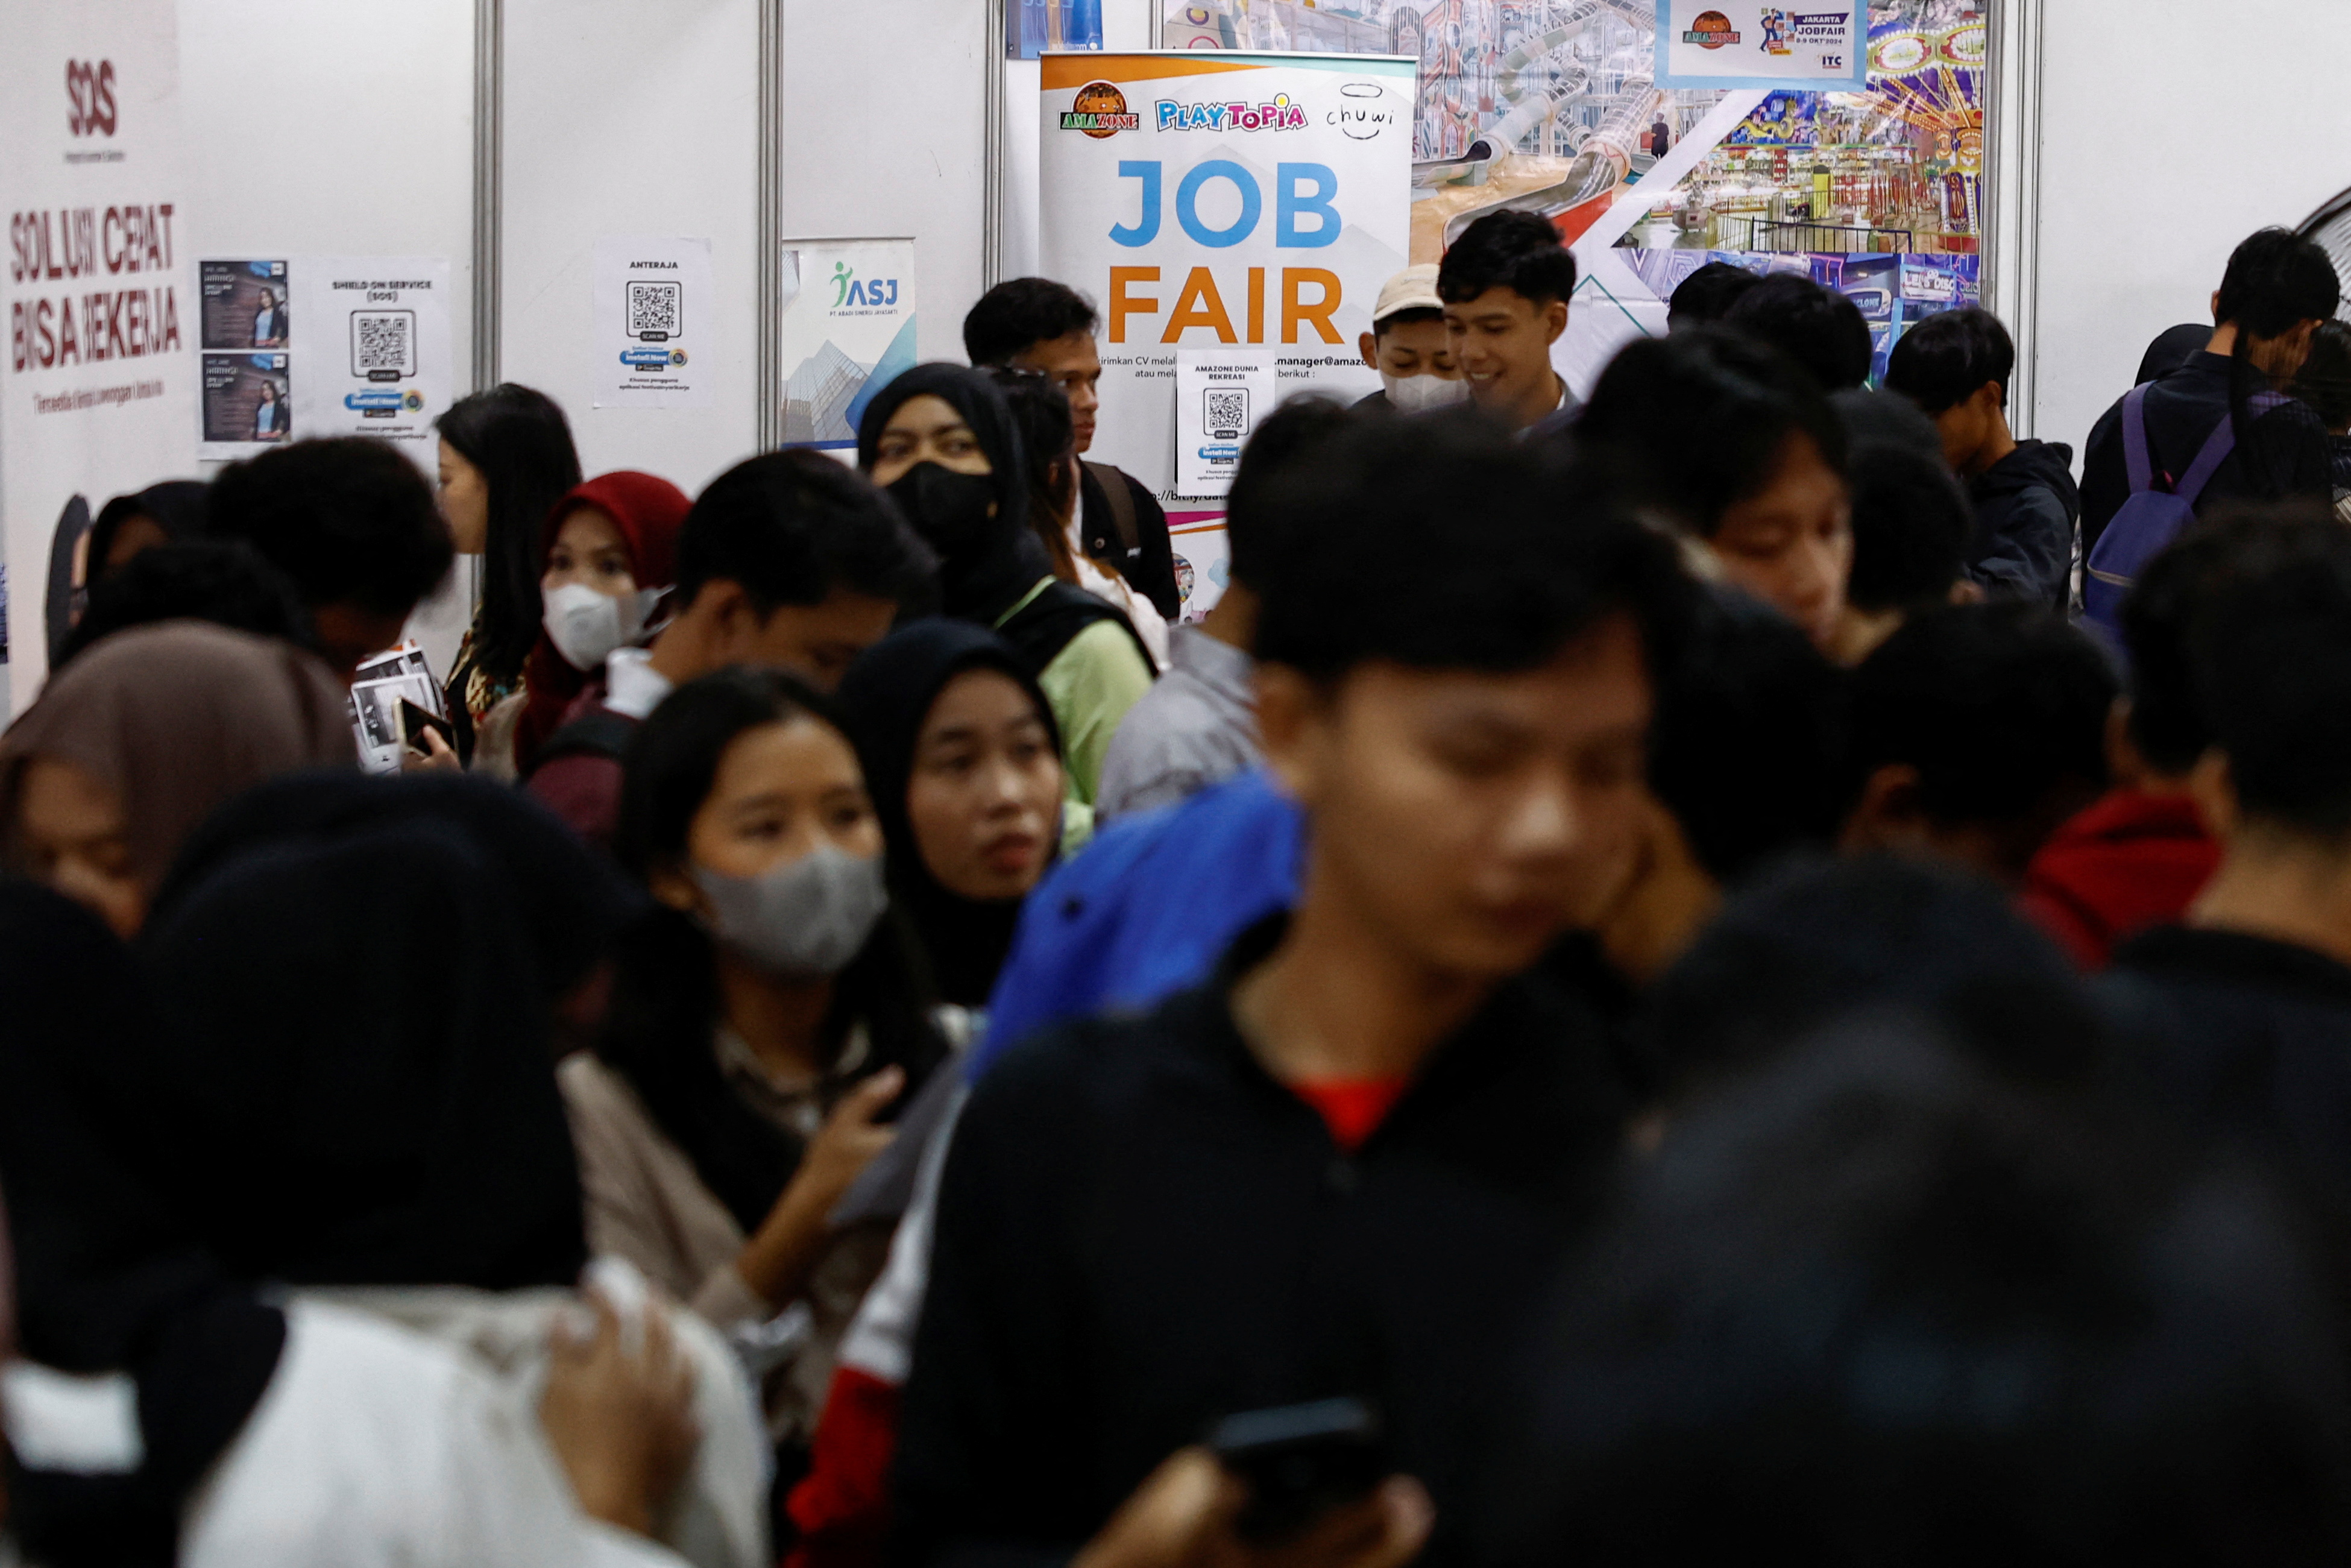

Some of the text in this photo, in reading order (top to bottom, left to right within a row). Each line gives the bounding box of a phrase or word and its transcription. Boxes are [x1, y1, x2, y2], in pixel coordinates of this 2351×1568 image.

[1684, 32, 1739, 43] AMAZONE
[1798, 27, 1845, 36] JOBFAIR
[1822, 56, 1842, 65] ITC
[66, 59, 116, 137] SOS
[1062, 113, 1138, 129] AMAZONE
[1327, 104, 1394, 125] chuwi
[1108, 159, 1342, 248] JOB
[104, 204, 174, 274] CEPAT
[846, 279, 898, 306] ASJ
[1109, 265, 1345, 345] FAIR
[1098, 356, 1133, 365] irimkan
[1135, 356, 1149, 365] CV
[1278, 369, 1309, 378] berikut
